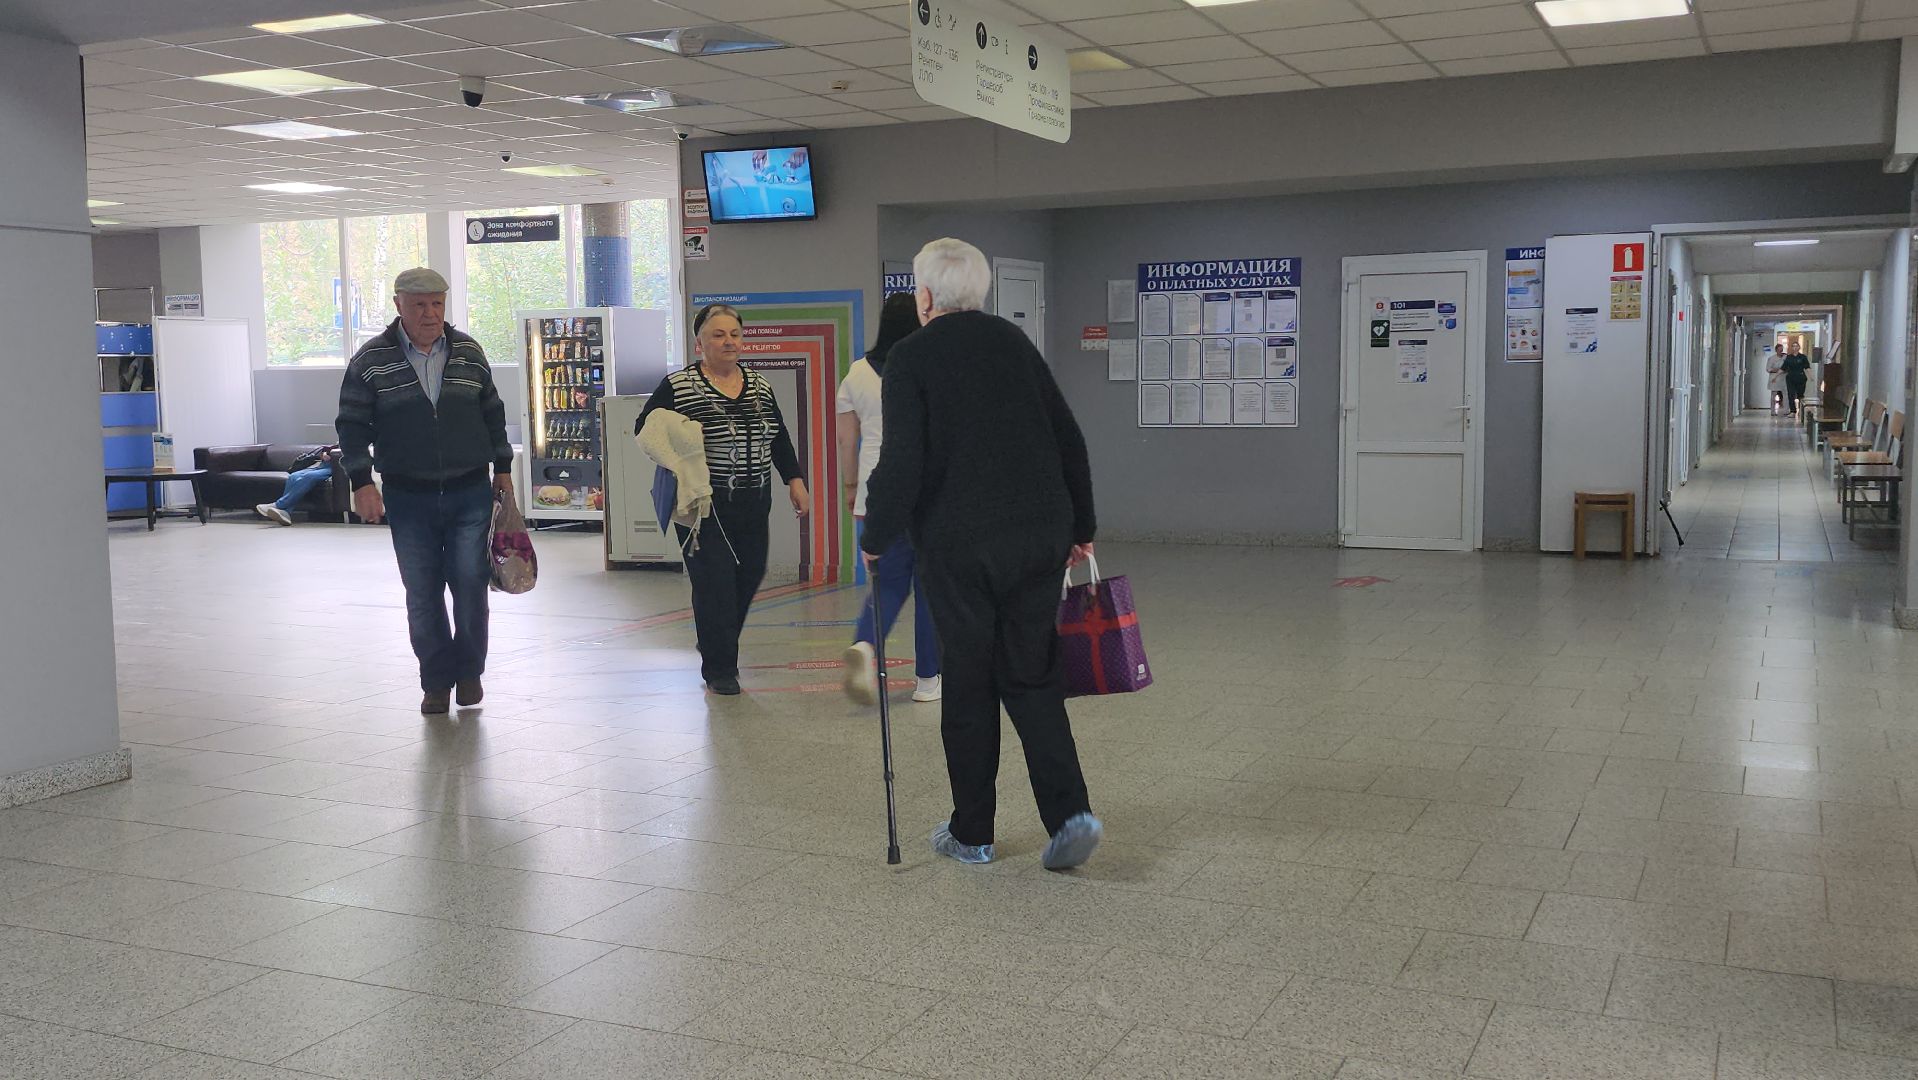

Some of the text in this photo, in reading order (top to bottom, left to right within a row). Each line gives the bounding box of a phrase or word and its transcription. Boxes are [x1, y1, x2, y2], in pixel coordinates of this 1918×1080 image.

[918, 52, 943, 71] Рентген
[976, 59, 1014, 84] Регистратура
[976, 75, 1004, 94] Гардероб
[976, 90, 995, 106] Выход
[487, 220, 554, 229] Зона комфортного
[487, 231, 523, 239] ожидания
[1147, 258, 1292, 278] ИНФОРМАЦИЯ
[1147, 275, 1292, 290] О ПЛАТНЫХ УСЛУГАХ
[757, 327, 784, 335] ПОМОЩИ
